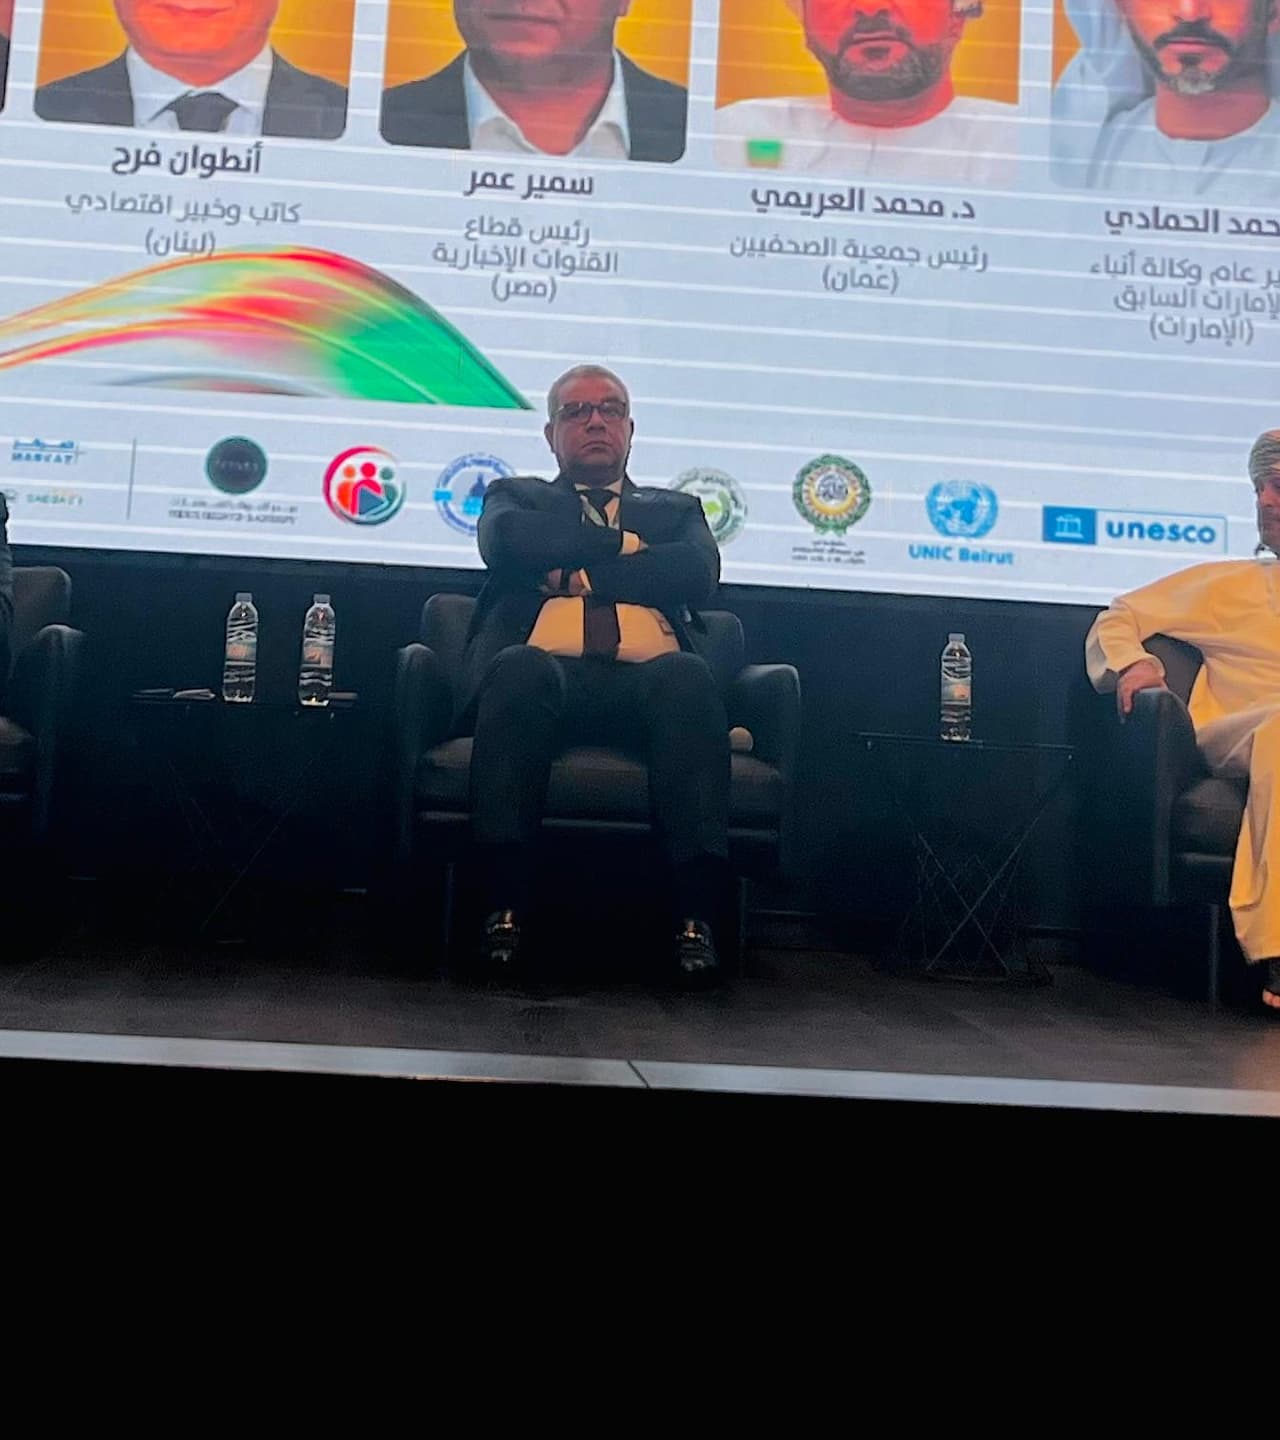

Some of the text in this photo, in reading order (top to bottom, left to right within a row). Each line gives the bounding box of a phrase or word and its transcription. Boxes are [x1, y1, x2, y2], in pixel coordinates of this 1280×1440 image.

[111, 141, 263, 178] أنطوان فرح
[463, 170, 593, 200] سمير عمر
[65, 191, 302, 226] كاتب وخبير اقتصادي
[751, 187, 975, 219] د. محمد العريمي
[464, 215, 590, 248] رئيس قطاع
[1105, 206, 1219, 235] الحمادي
[145, 227, 216, 257] (لبنان)
[730, 234, 989, 272] رئيس جمعية الصحفيين
[432, 242, 618, 276] القنوات الإخبارية
[1090, 251, 1136, 277] أنباء
[1142, 257, 1202, 286] وكالة
[1210, 262, 1254, 286] عام
[491, 273, 557, 303] (مصر)
[1114, 285, 1196, 311] السابق
[1150, 313, 1254, 347] (الإمارات)
[1105, 520, 1216, 545] unesco
[909, 544, 1014, 566] UNIC Beirut
